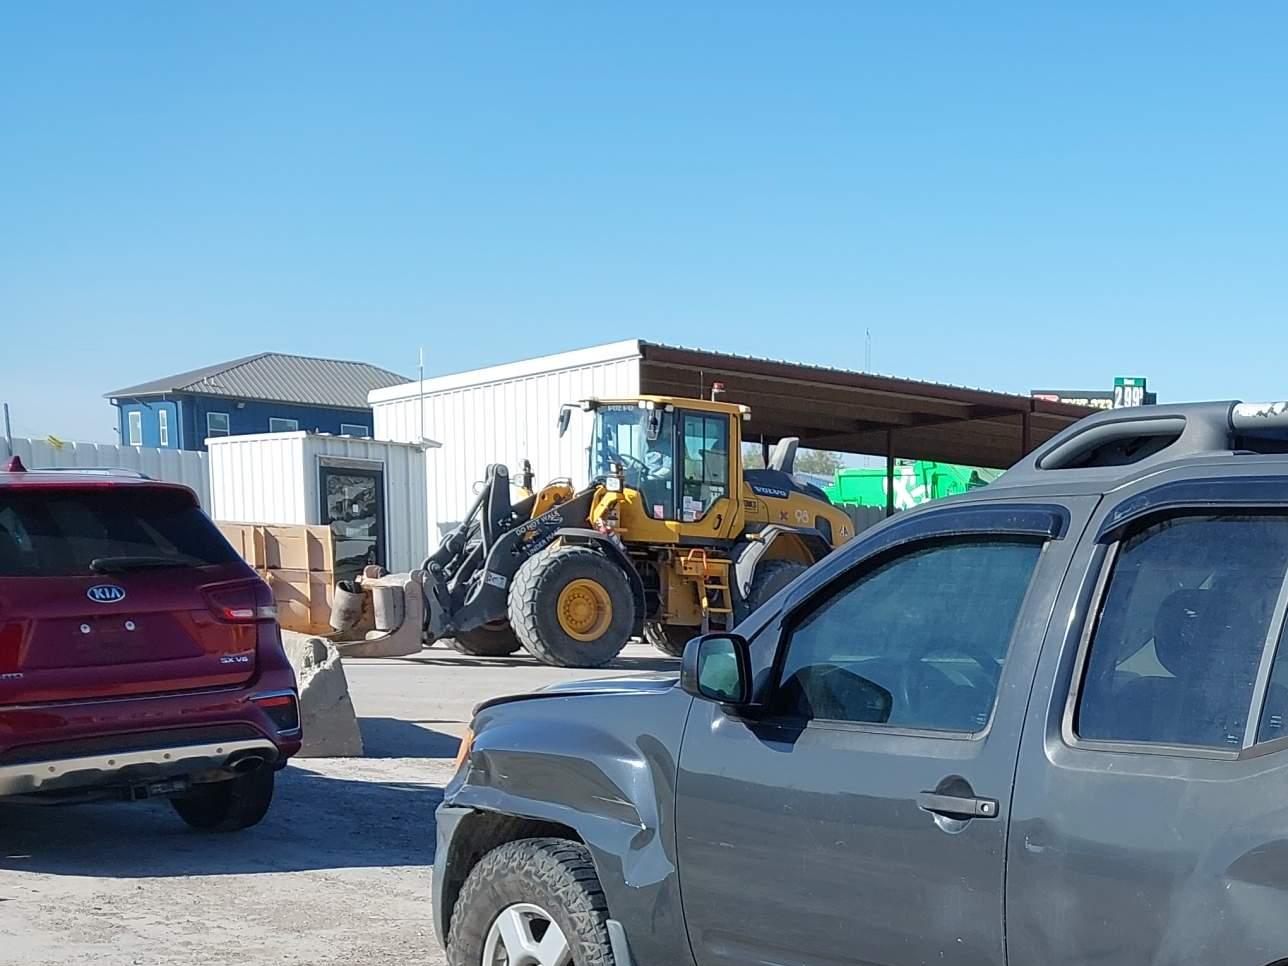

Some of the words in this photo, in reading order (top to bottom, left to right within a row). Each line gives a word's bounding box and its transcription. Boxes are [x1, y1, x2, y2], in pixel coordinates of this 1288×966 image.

[754, 486, 787, 497] VOLVO
[515, 527, 526, 536] DO
[526, 519, 541, 530] NOT
[93, 588, 121, 599] KIA
